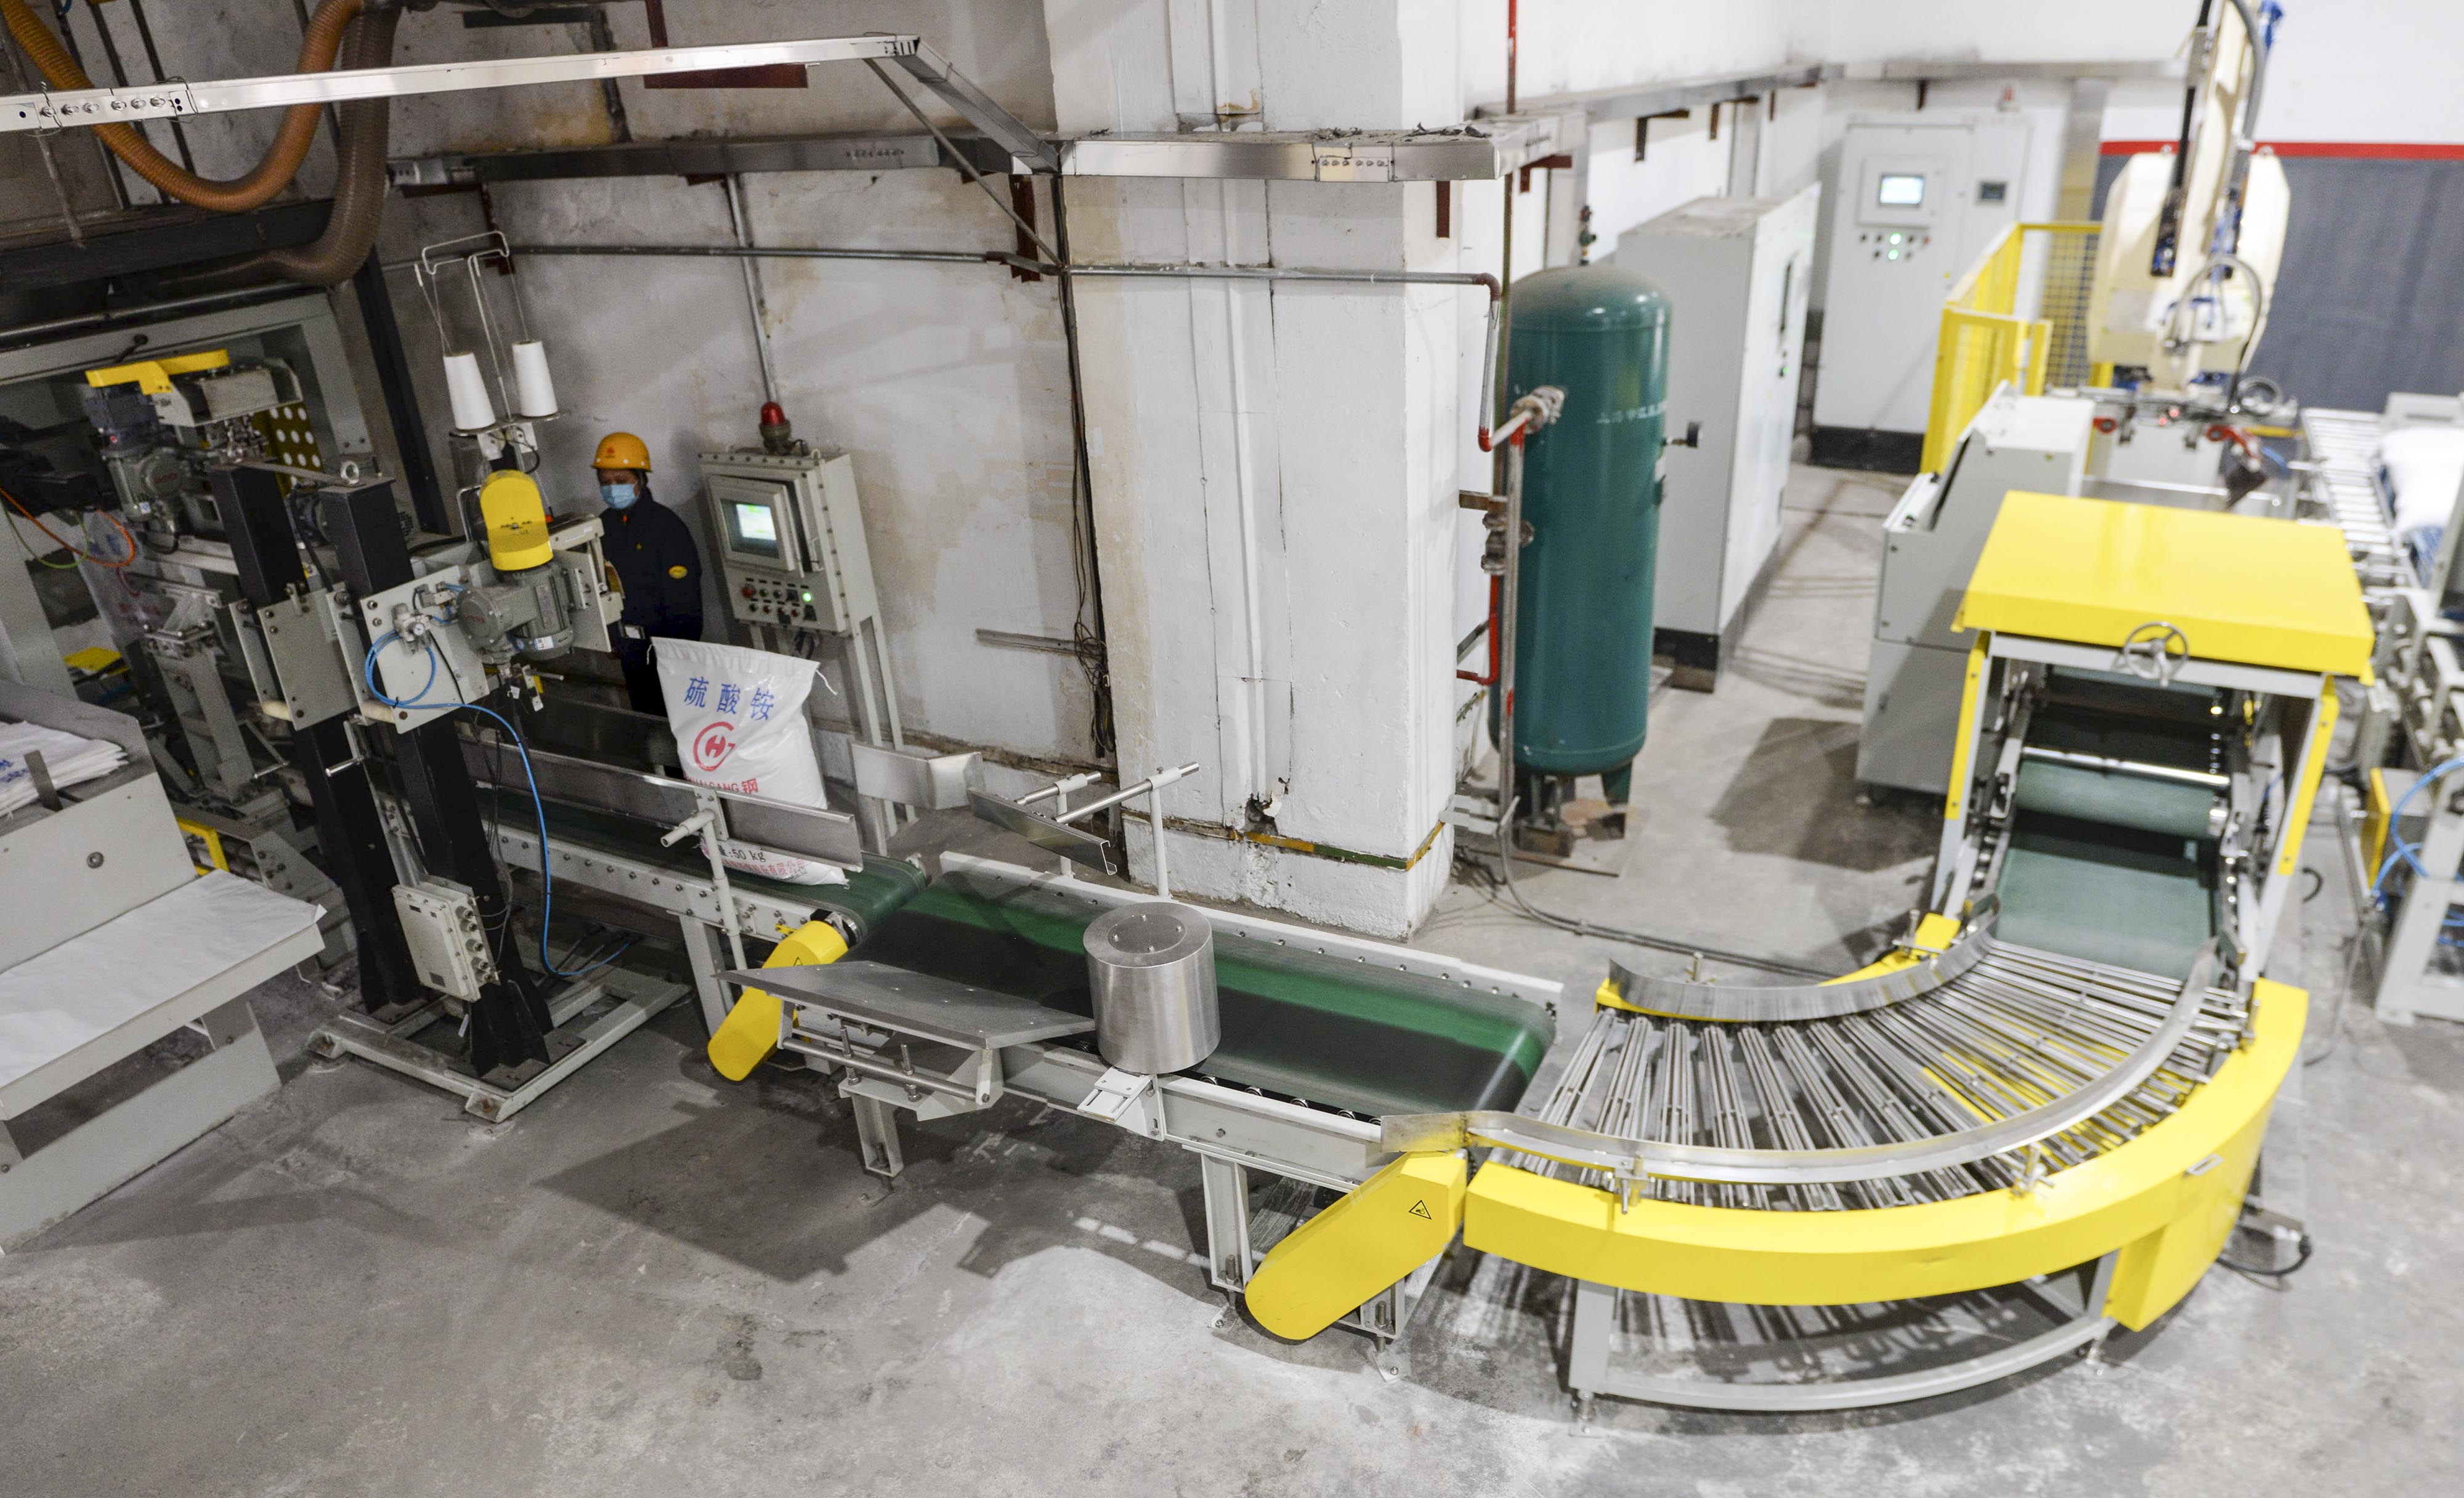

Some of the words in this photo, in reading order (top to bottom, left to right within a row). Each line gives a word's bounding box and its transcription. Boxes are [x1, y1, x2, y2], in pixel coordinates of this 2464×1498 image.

[684, 676, 774, 721] 硫酸铵
[749, 850, 766, 862] kg
